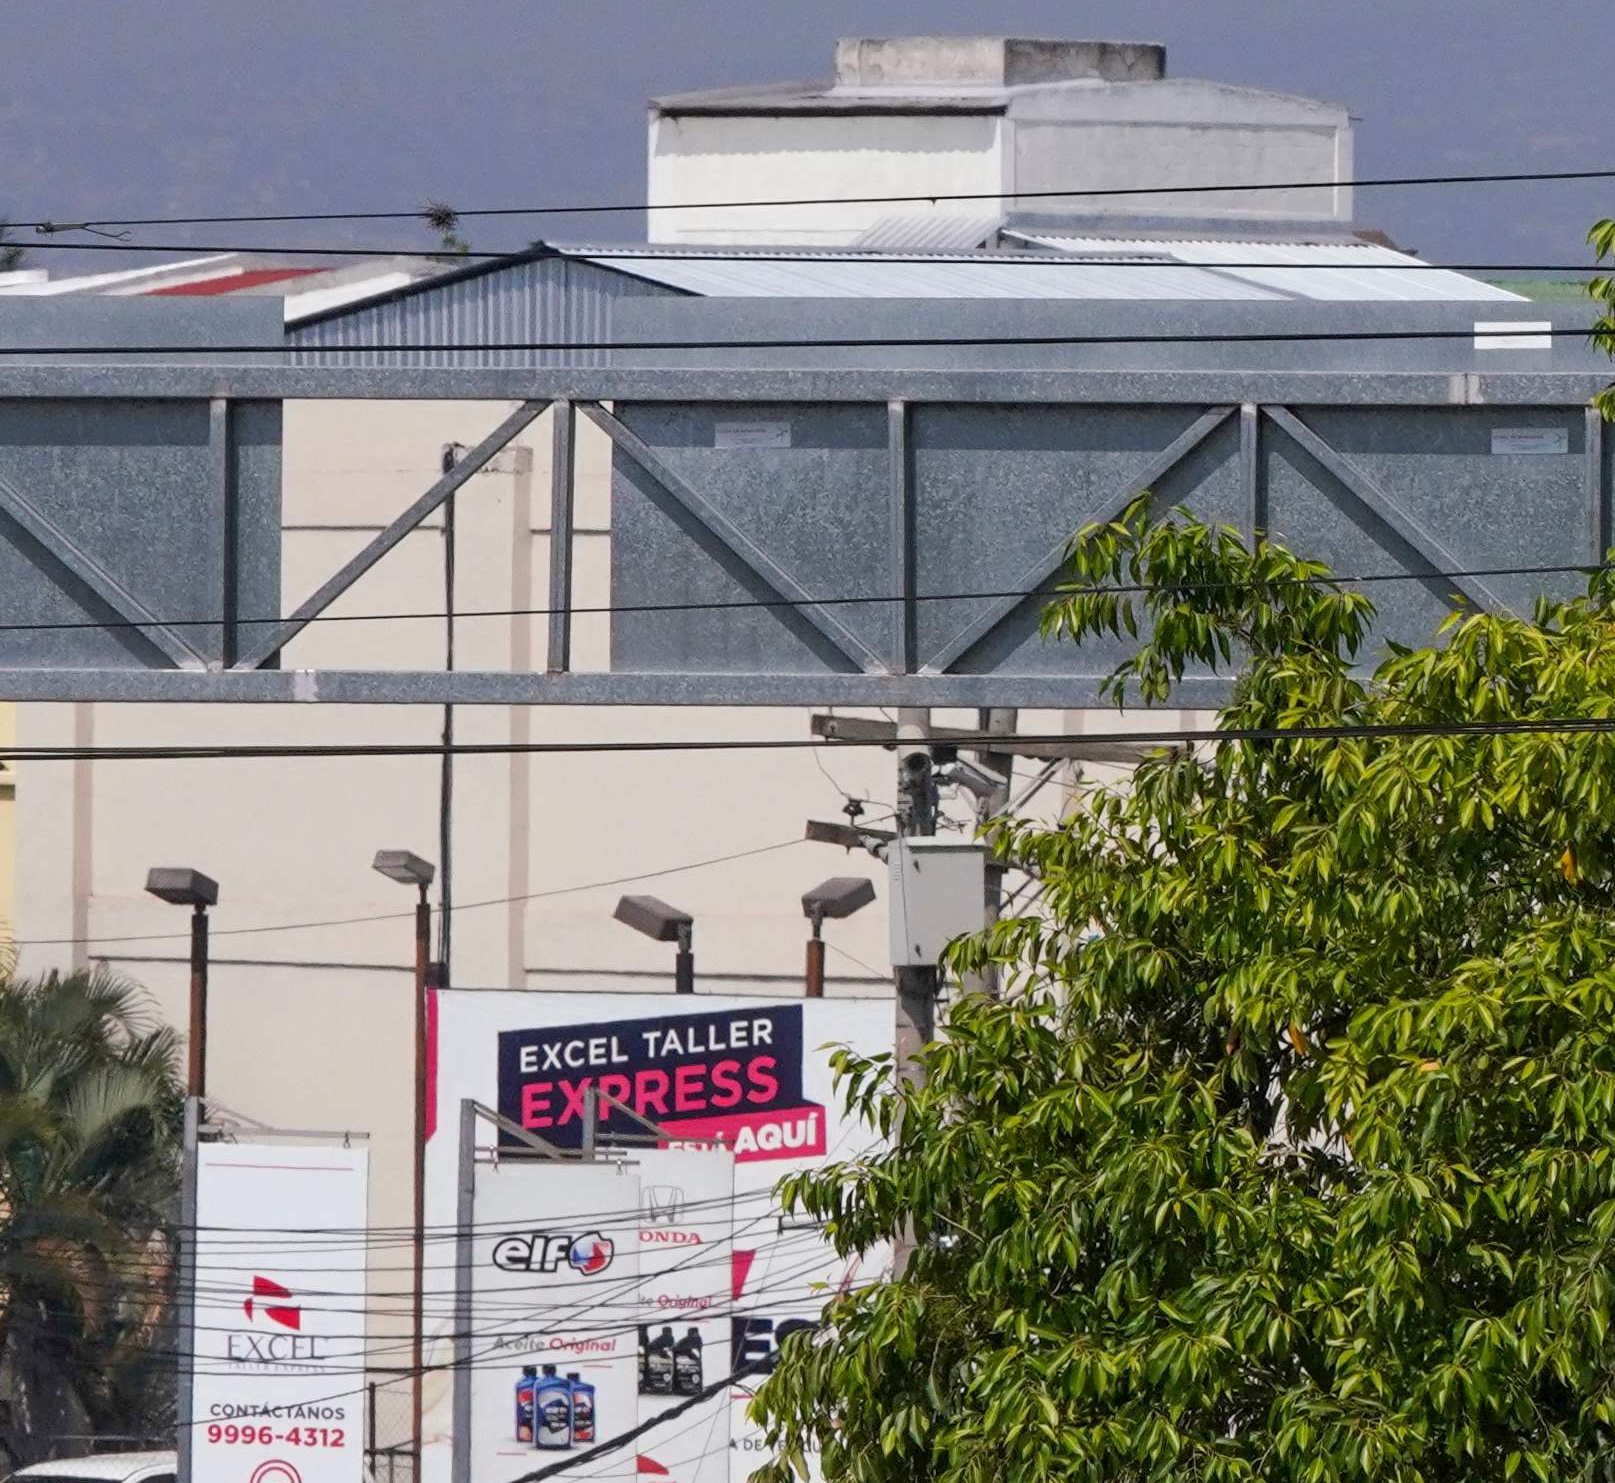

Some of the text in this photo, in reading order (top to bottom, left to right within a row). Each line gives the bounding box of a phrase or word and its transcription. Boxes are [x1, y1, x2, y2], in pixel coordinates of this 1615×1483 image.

[519, 1018, 774, 1073] EXCEL TALLER
[520, 1055, 780, 1130] EXPRESS
[734, 1112, 817, 1154] AQUÍ
[639, 1230, 703, 1246] ONDA
[493, 1233, 570, 1272] elf
[656, 1294, 713, 1309] Original
[226, 1334, 324, 1360] EXCEL
[494, 1336, 617, 1354] Aceite Original
[210, 1400, 346, 1421] CONTÁCTANOS
[207, 1423, 346, 1448] 9996-4312
